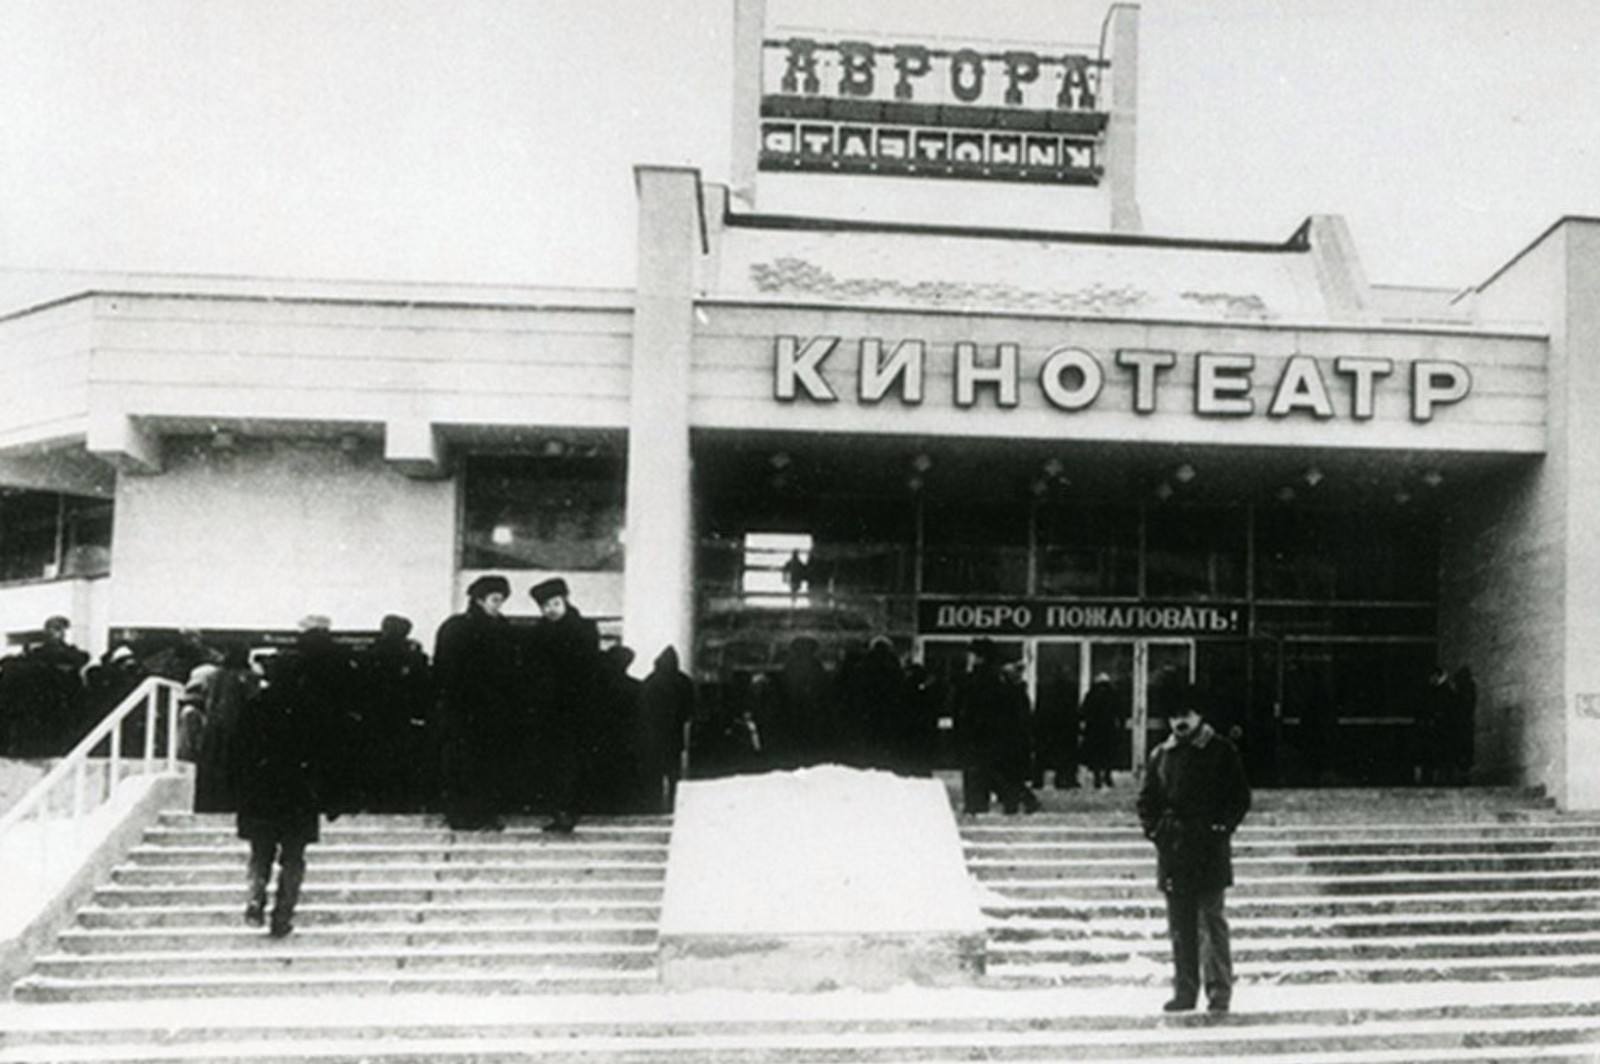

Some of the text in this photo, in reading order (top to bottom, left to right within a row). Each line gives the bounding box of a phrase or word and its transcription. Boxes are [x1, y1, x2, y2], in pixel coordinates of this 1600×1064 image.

[782, 39, 1096, 109] АВРОРА
[773, 335, 1472, 422] КИНОТЕАТР
[936, 605, 1239, 631] ДОБРО ПОЖАЛОВАТЬ!
